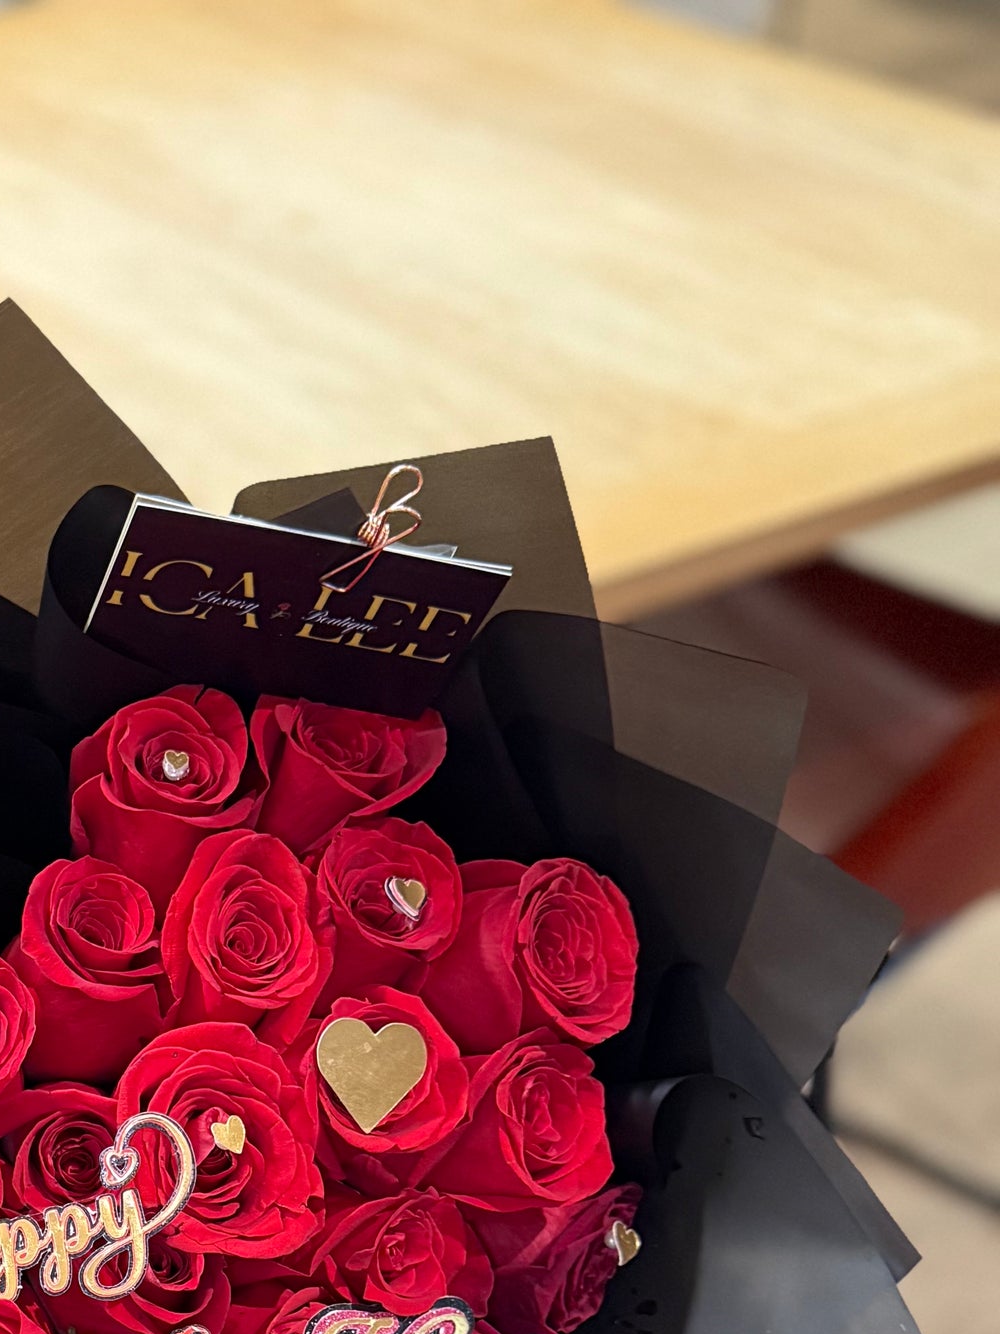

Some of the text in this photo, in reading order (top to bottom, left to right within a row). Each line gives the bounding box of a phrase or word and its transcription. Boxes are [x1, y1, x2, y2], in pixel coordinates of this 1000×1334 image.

[104, 550, 473, 665] ICA LEE
[191, 590, 379, 637] Luxury Boutique
